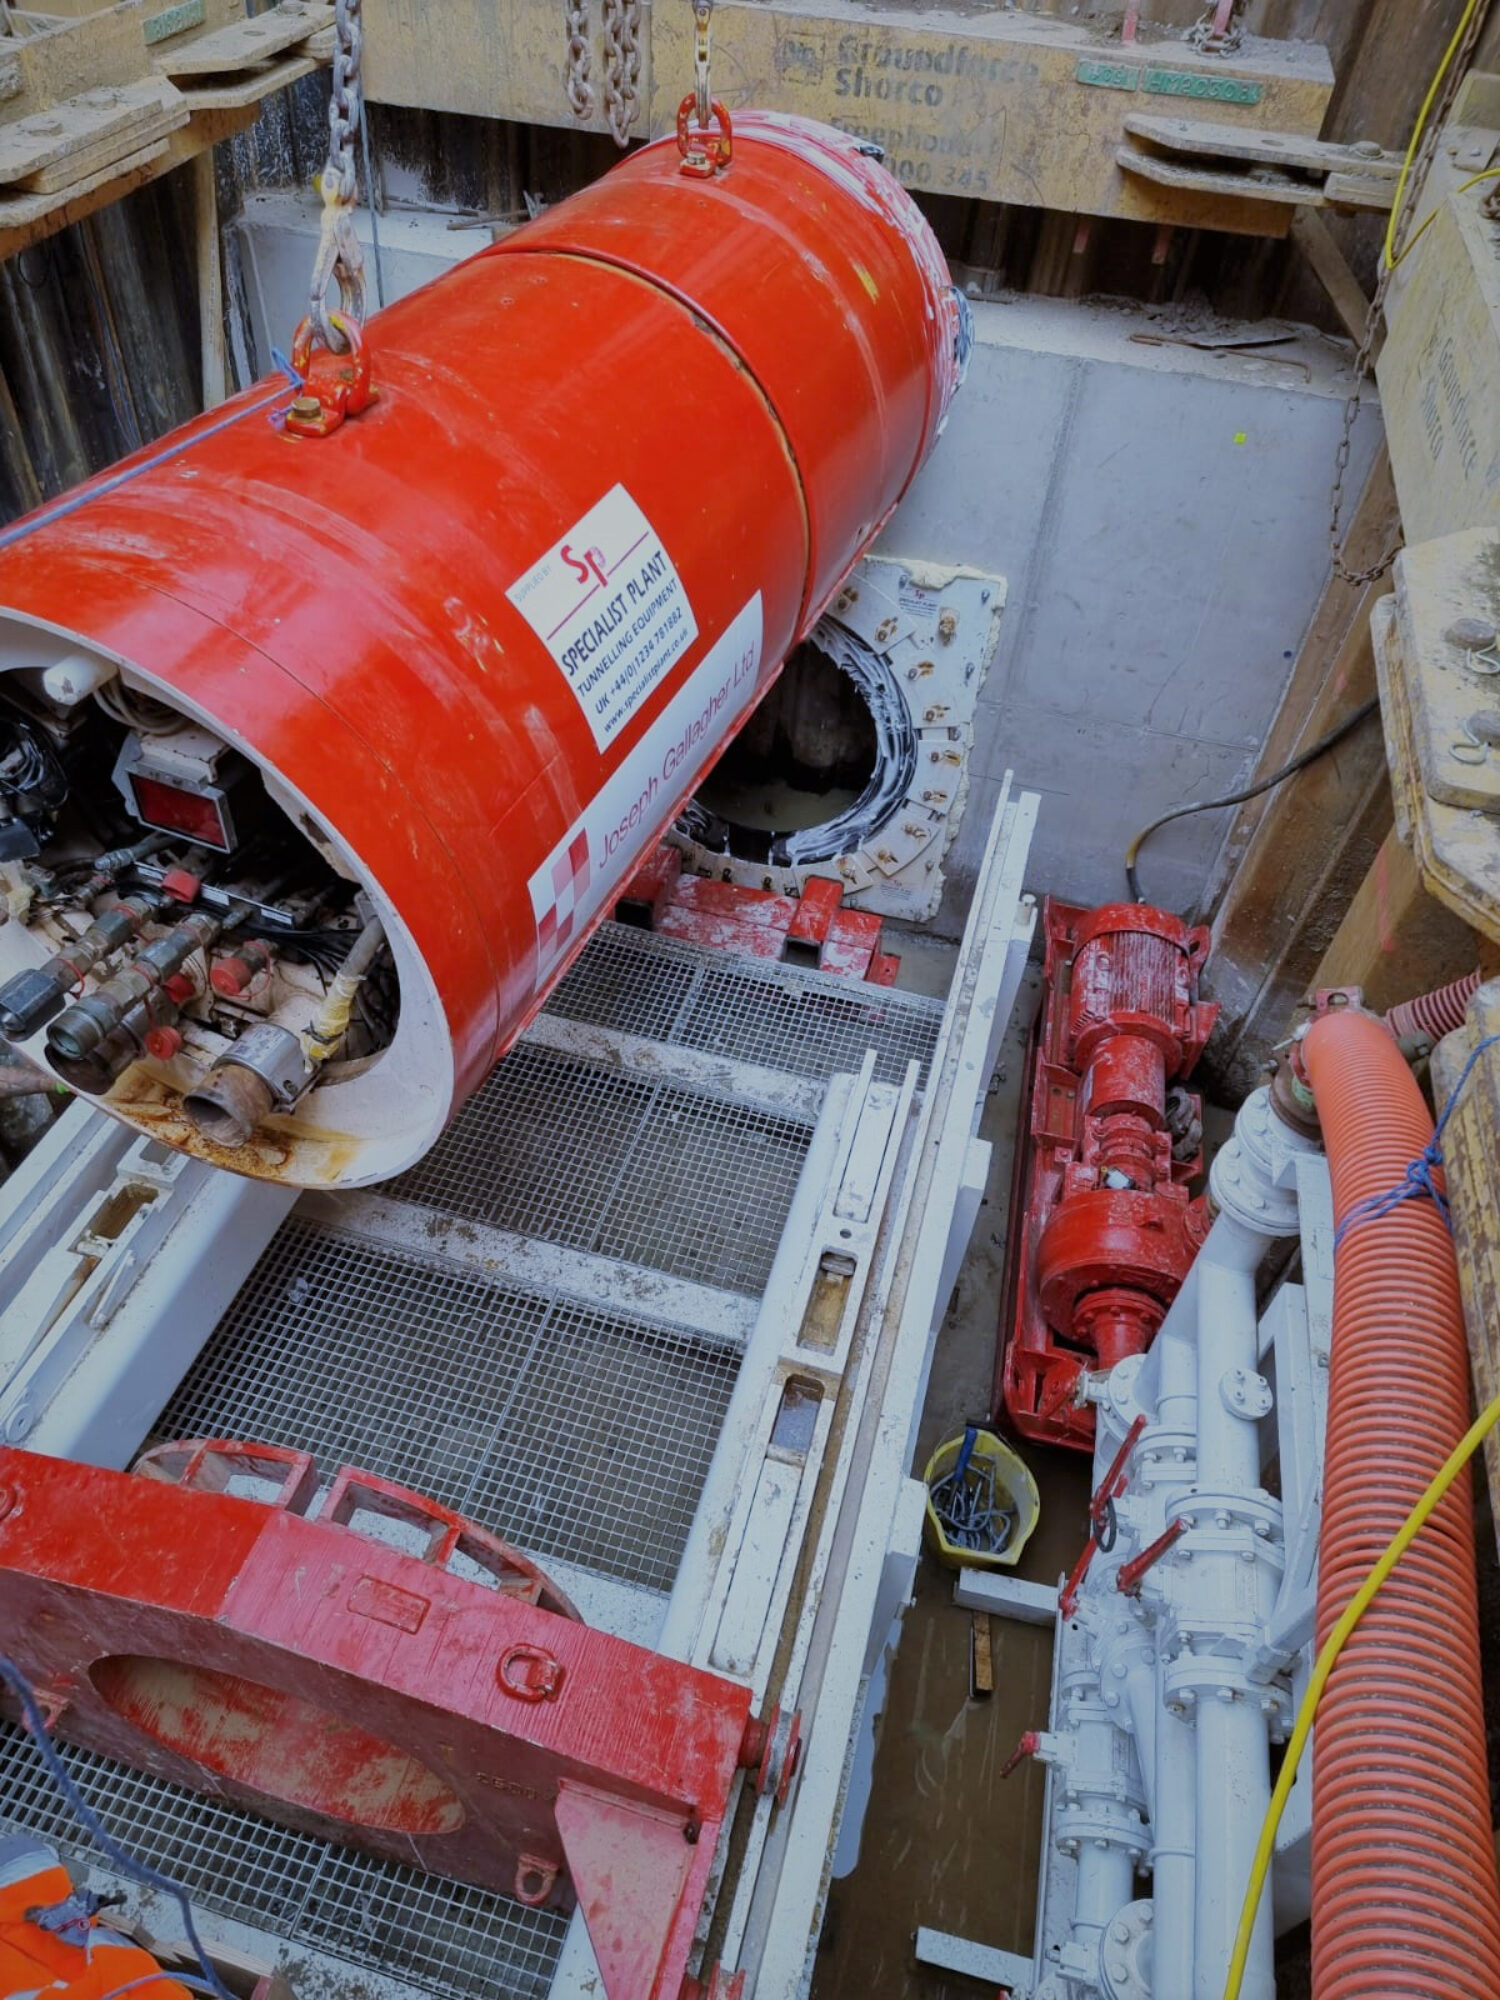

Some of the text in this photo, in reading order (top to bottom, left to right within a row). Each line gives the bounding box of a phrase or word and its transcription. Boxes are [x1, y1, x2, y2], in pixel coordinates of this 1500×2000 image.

[834, 67, 943, 107] Shorco
[561, 551, 667, 676] SPECIALIST PLANT
[577, 578, 678, 697] TUNNELLING EQUIPMENT
[595, 692, 610, 714] UK
[599, 640, 755, 868] Joseph Gallagher Ltd
